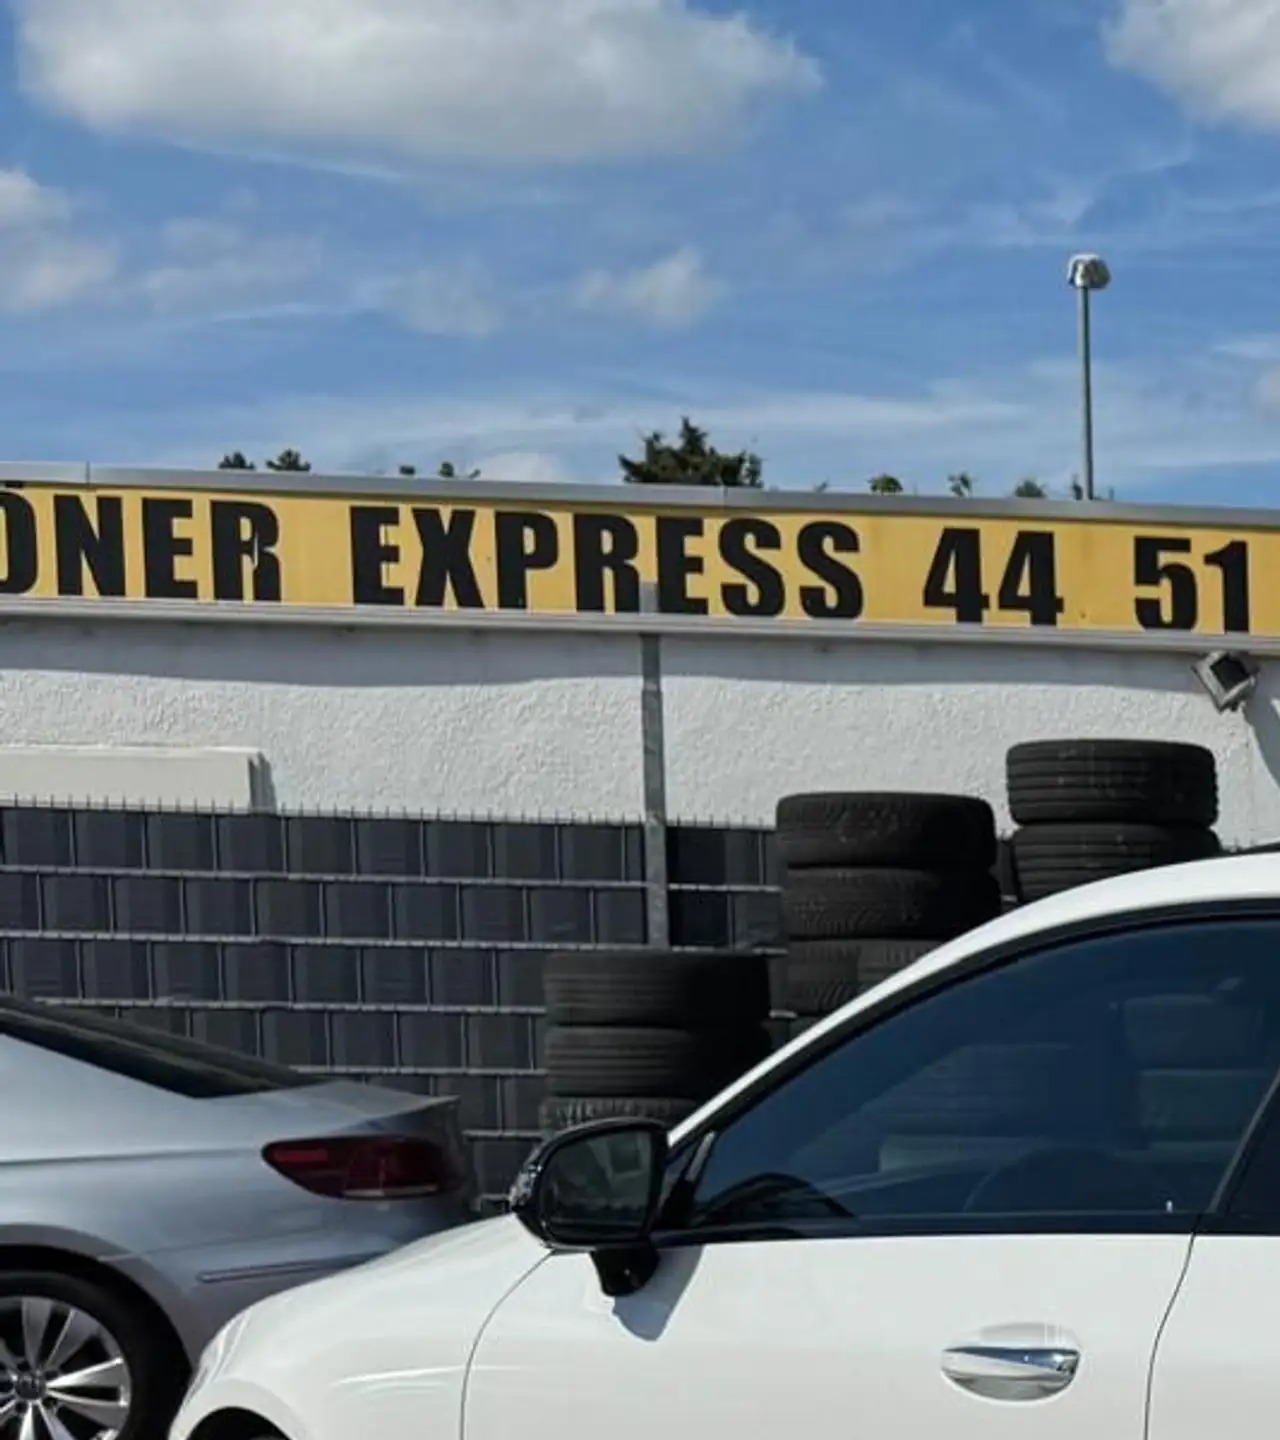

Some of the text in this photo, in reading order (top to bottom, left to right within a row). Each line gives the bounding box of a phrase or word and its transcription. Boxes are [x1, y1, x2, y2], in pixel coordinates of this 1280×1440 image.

[350, 506, 864, 620] EXPRESS
[923, 527, 1065, 625] 44
[1133, 536, 1250, 632] 51
